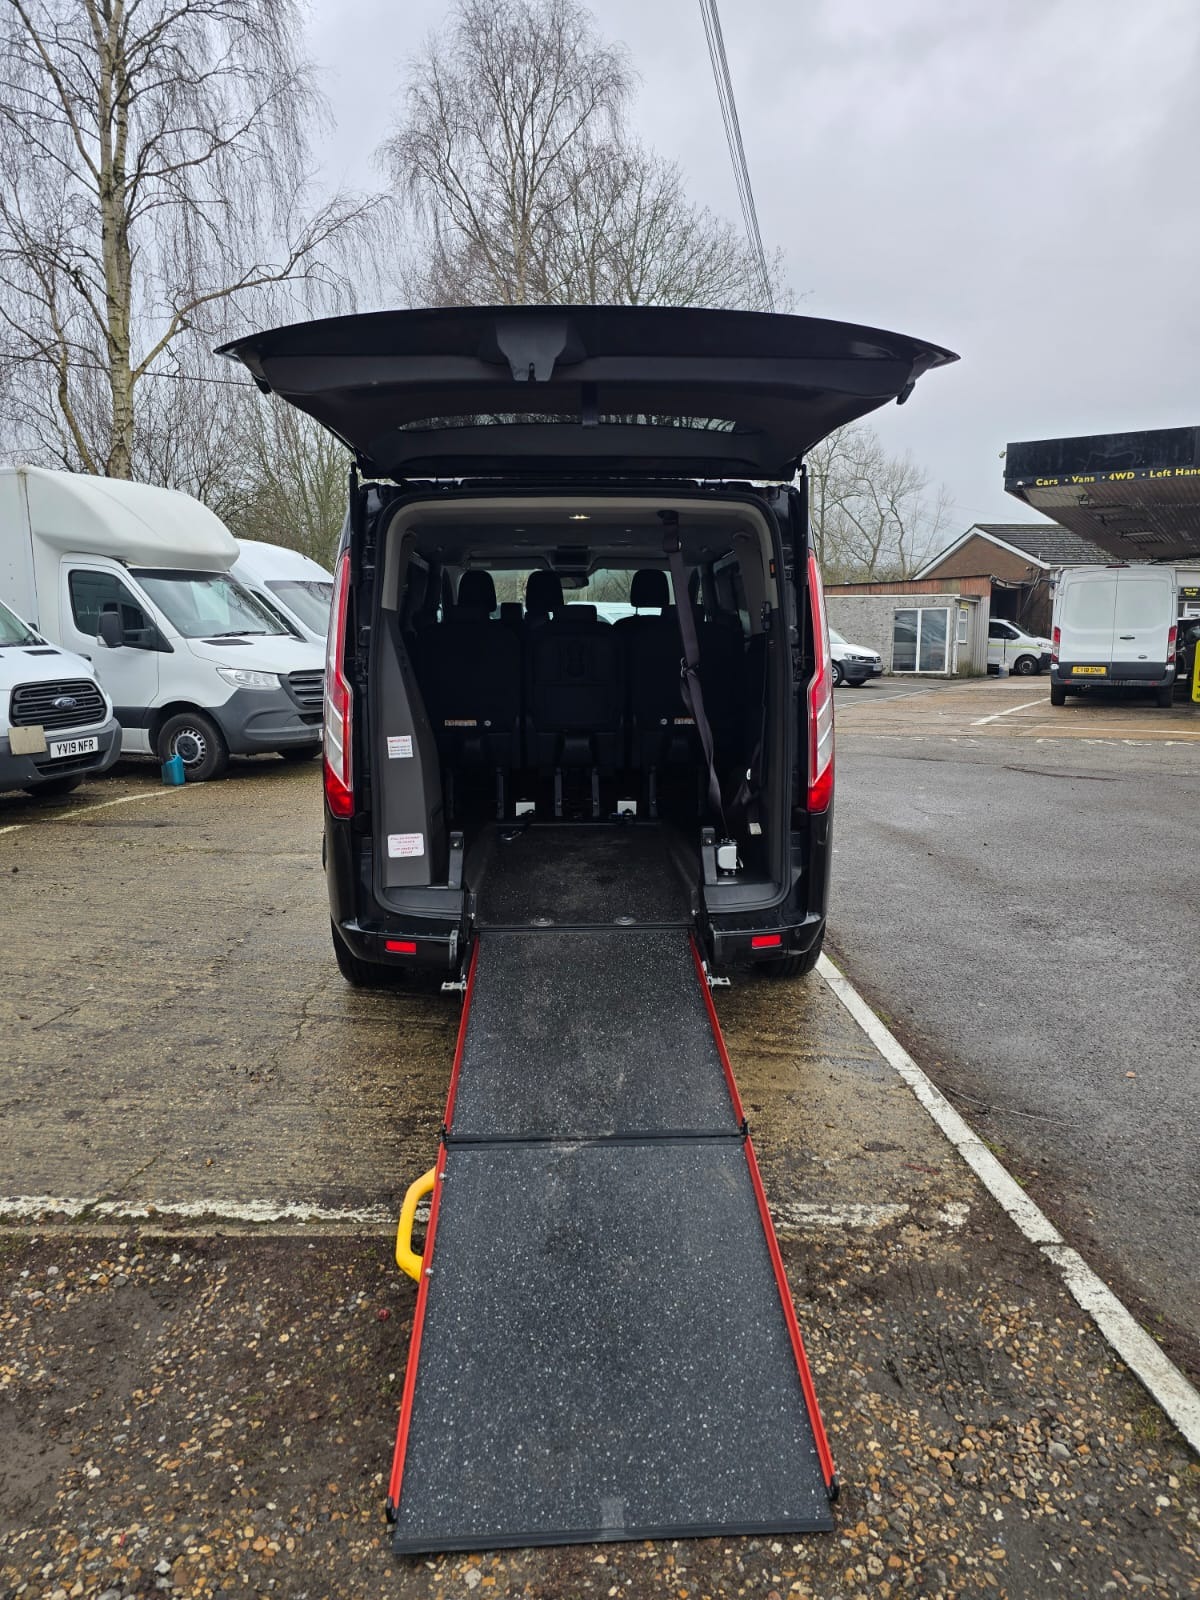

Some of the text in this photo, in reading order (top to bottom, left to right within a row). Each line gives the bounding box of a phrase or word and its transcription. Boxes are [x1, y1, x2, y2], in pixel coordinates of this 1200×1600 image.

[1035, 478, 1059, 487] Cars
[1071, 475, 1096, 484] Vans
[1108, 471, 1136, 481] 4WD
[1149, 469, 1172, 478] Left
[56, 739, 94, 756] YV19 NFR
